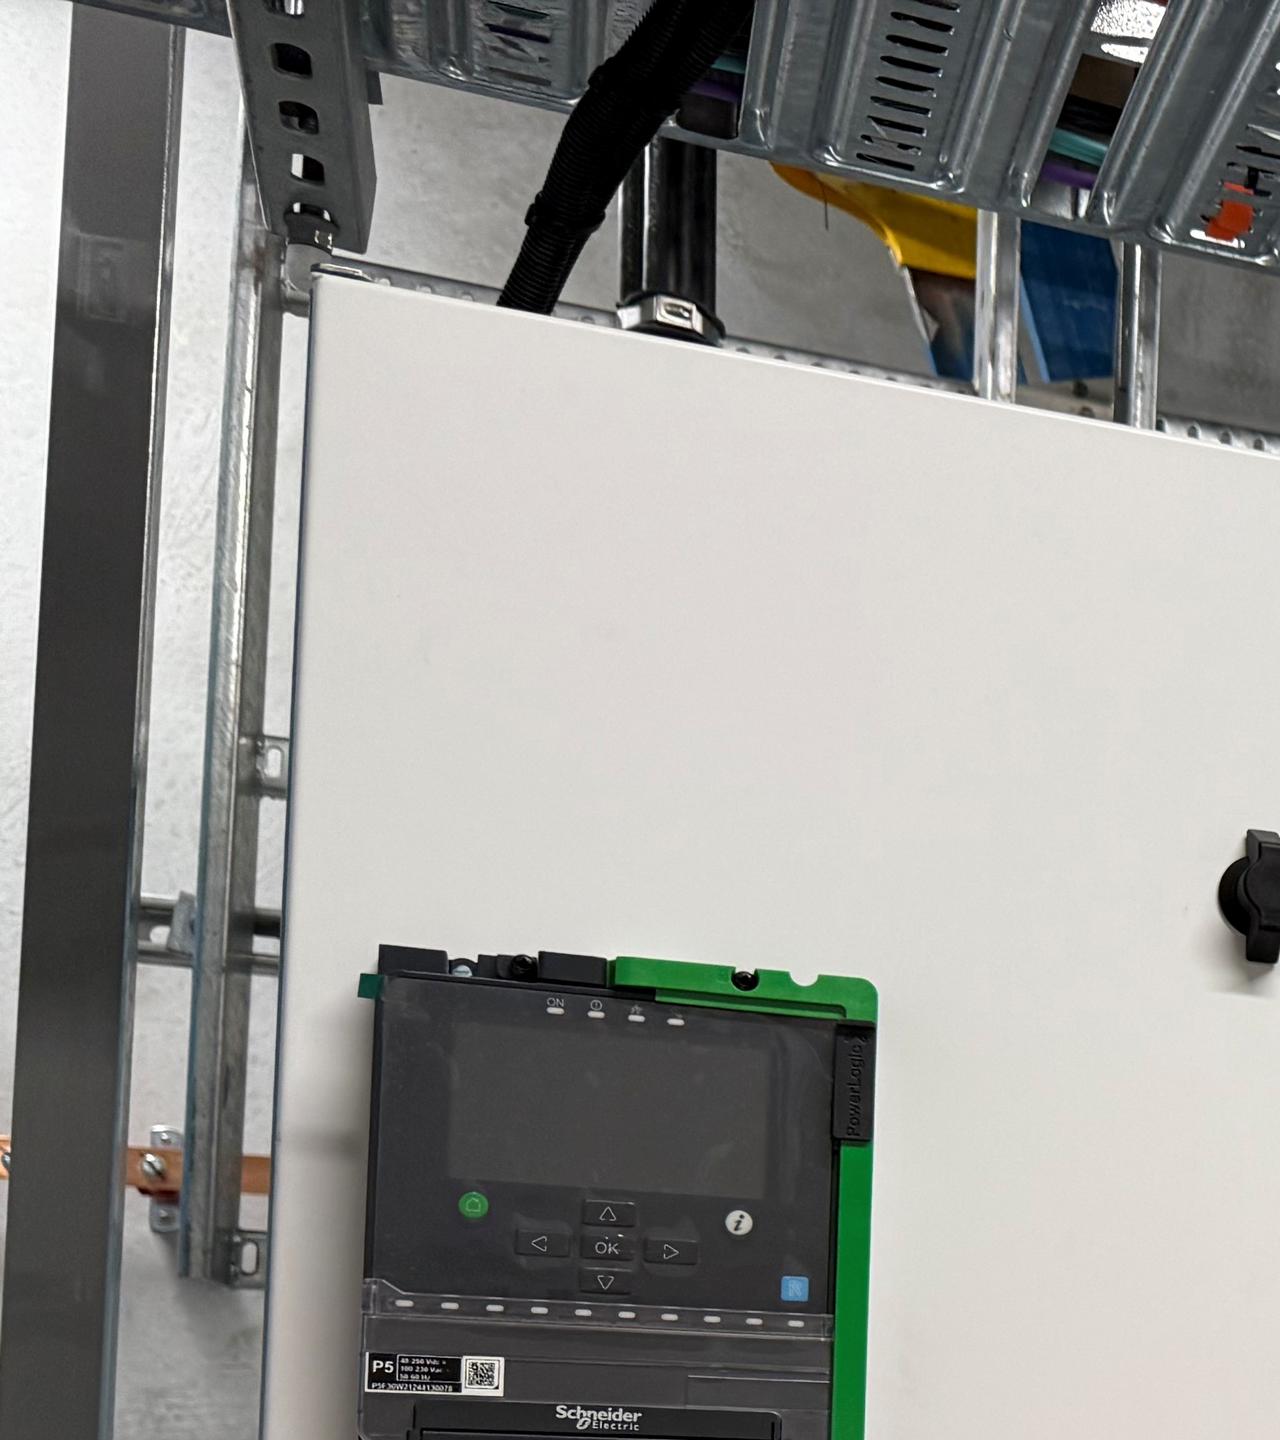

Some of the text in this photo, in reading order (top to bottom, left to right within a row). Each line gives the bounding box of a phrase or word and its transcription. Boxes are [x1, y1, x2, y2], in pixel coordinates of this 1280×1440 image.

[547, 997, 564, 1007] ON
[846, 1044, 864, 1137] PowerLogic
[595, 1242, 619, 1255] OK
[372, 1360, 394, 1374] P5
[555, 1404, 642, 1422] Schneider
[592, 1420, 640, 1431] Electric
